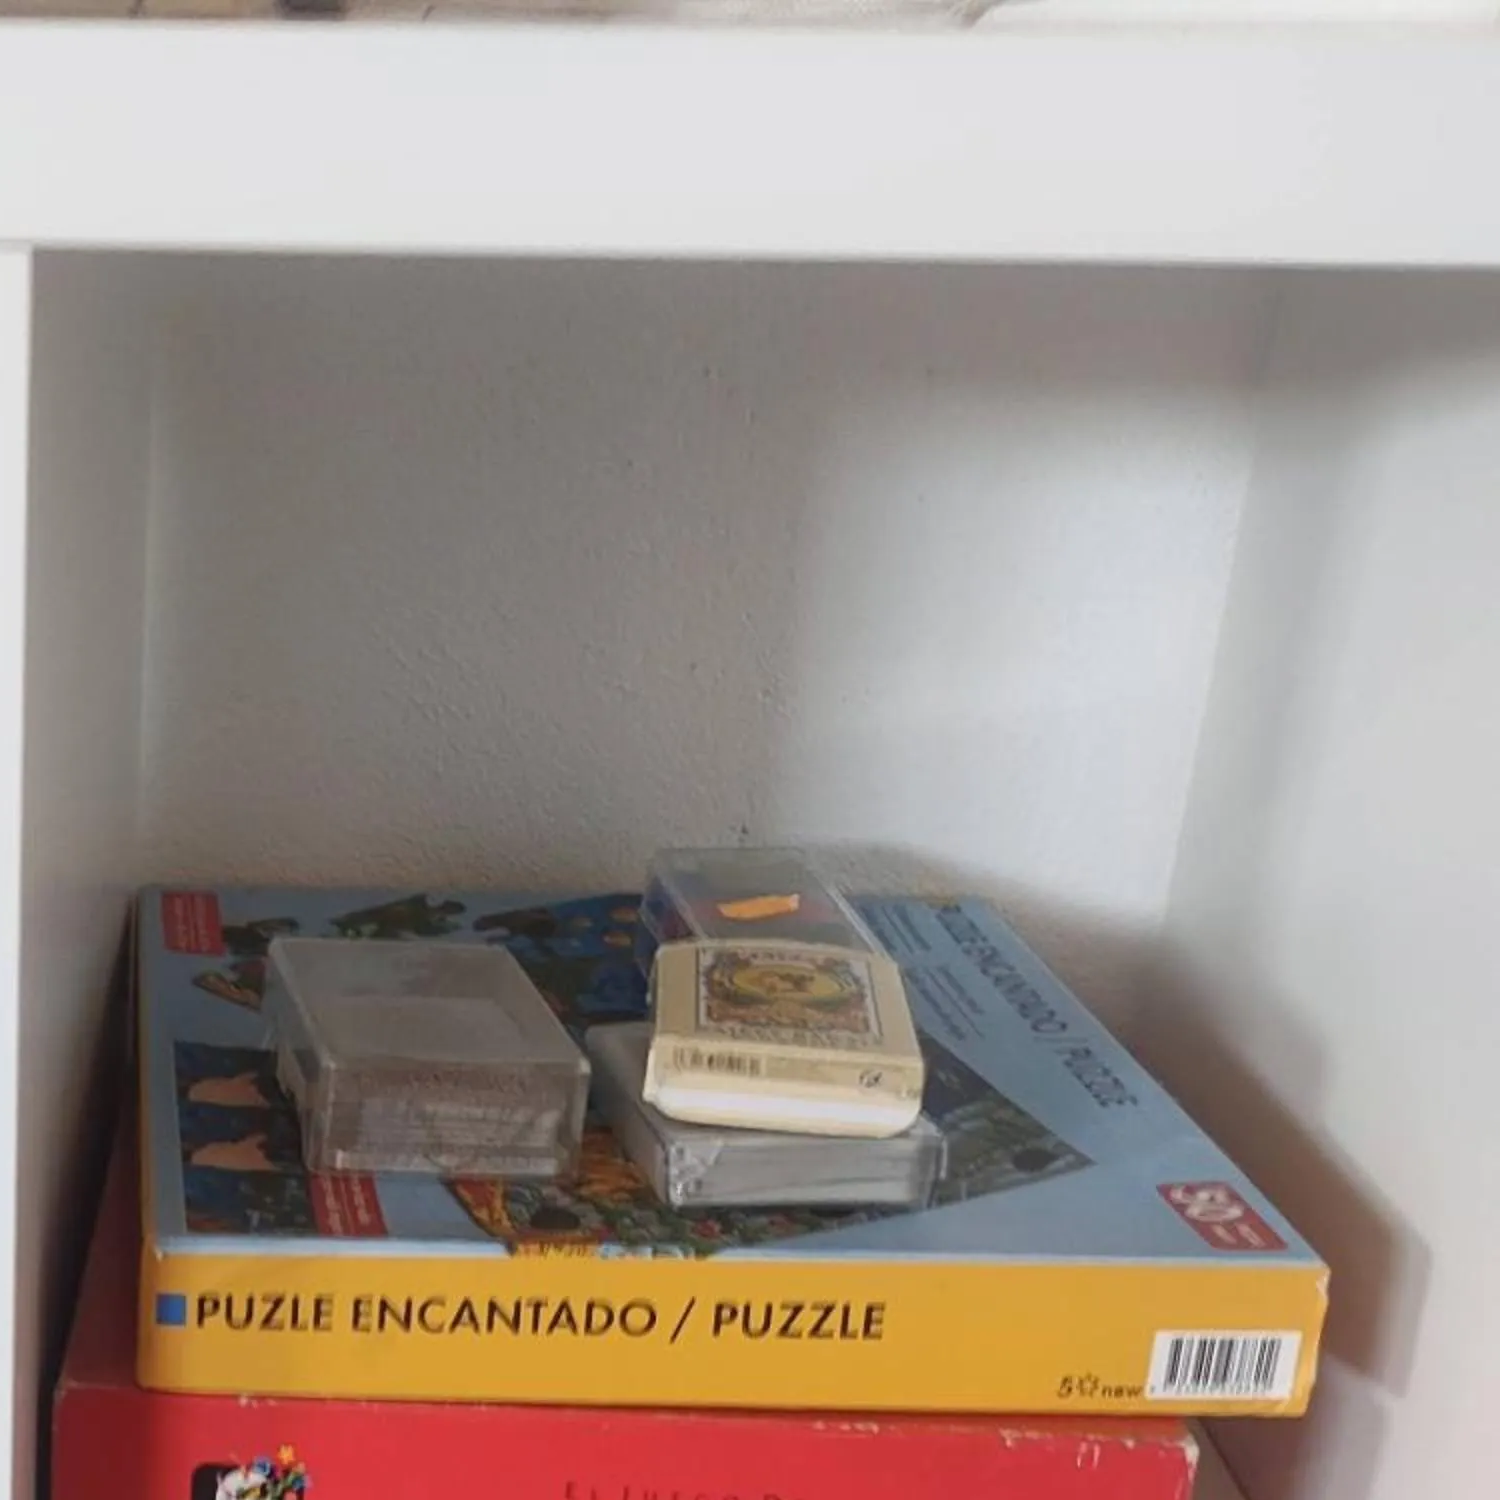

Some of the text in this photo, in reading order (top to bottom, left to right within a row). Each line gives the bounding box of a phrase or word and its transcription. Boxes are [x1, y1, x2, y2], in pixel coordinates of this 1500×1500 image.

[196, 1294, 887, 1343] PUZLE ENCANTADO / PUZZLE
